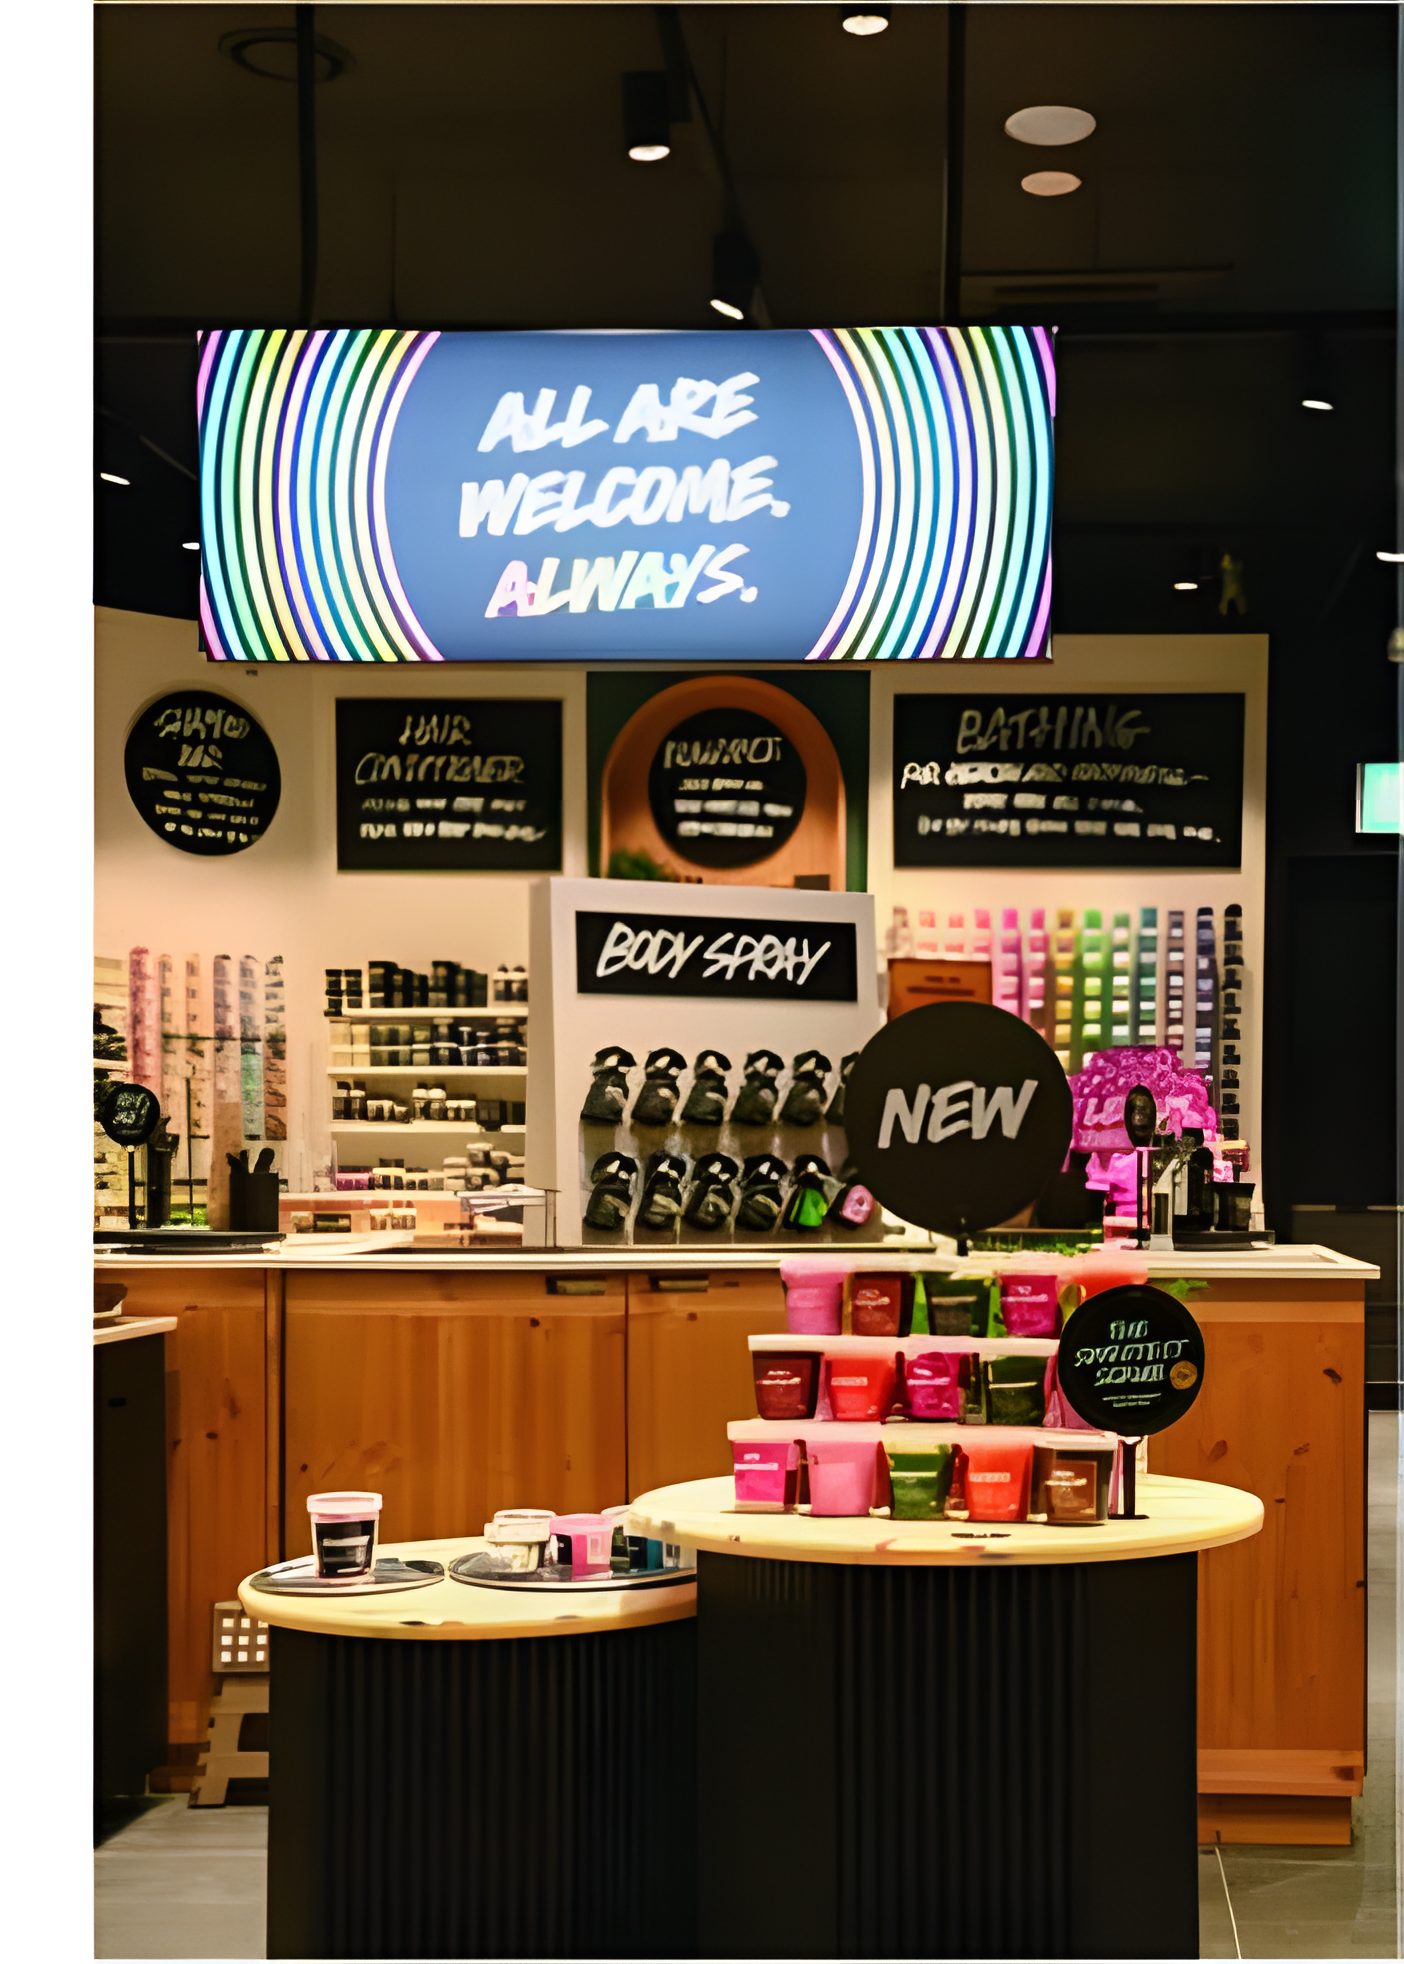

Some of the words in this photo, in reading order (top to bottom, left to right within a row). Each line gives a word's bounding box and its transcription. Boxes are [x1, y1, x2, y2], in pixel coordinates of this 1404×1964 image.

[477, 385, 609, 453] ALL
[613, 372, 760, 443] ARE
[459, 455, 791, 538] WELCOME.
[484, 543, 758, 618] ALWAYS.
[596, 921, 704, 979] BODY
[702, 932, 831, 985] SPRAY
[878, 1079, 1039, 1149] NEW
